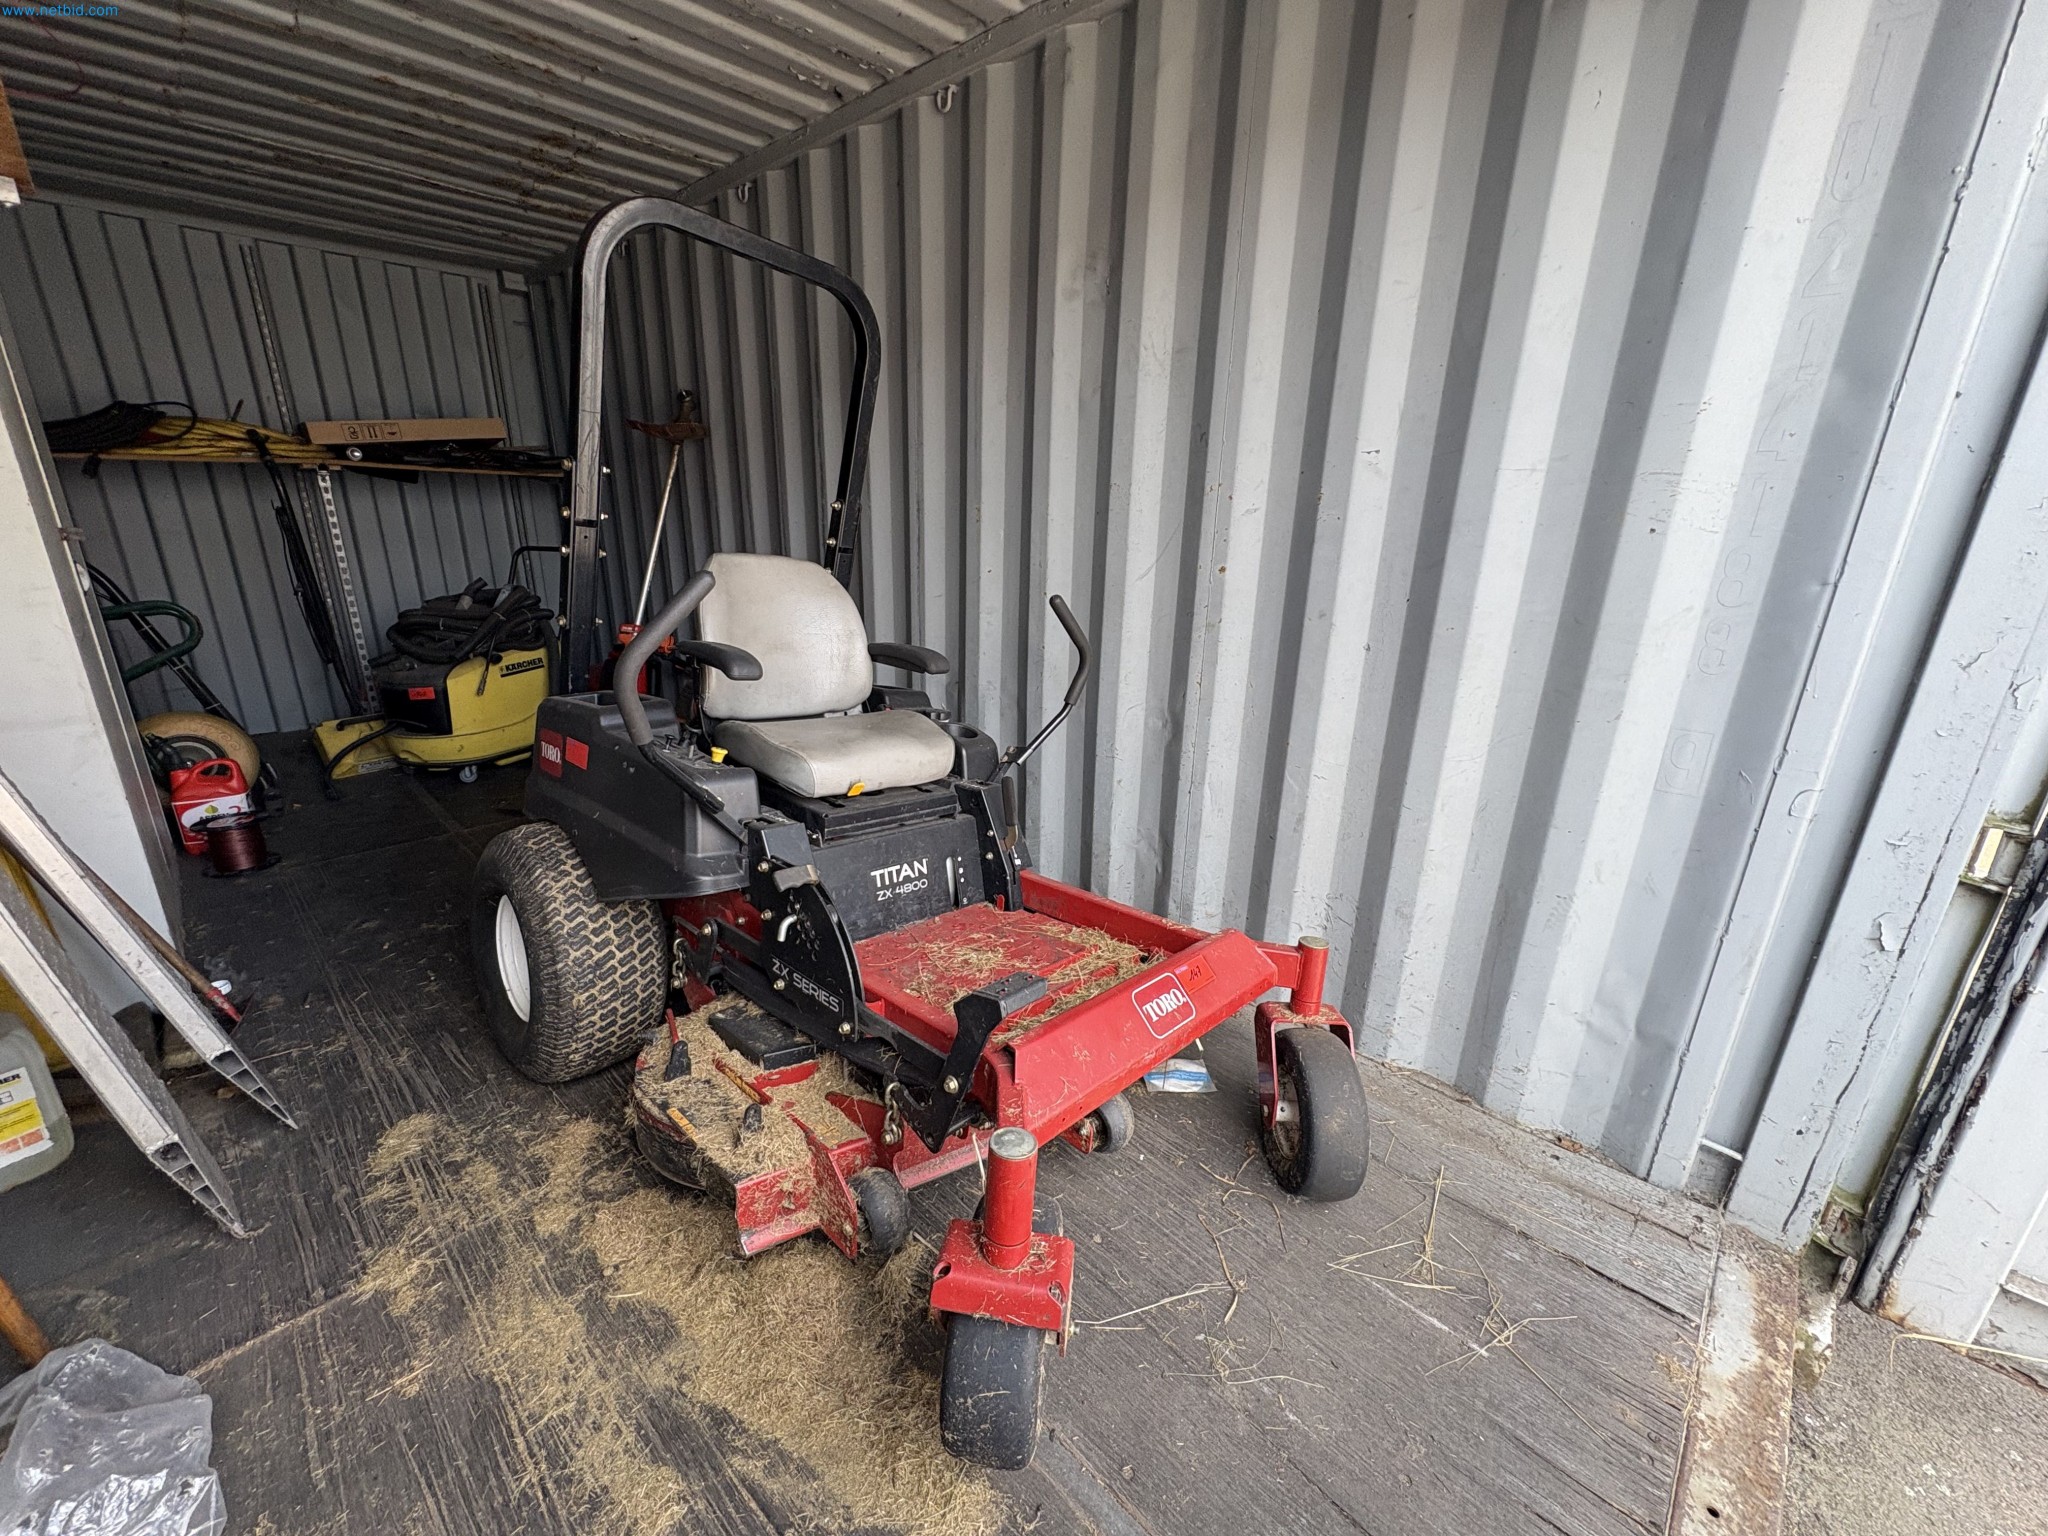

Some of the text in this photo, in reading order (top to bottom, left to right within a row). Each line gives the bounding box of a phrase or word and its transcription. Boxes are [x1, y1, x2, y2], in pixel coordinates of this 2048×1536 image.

[540, 740, 561, 764] TORO
[870, 858, 929, 888] TITAN
[876, 878, 928, 901] ZX 4800
[772, 957, 840, 1013] ZX SERIES
[1142, 988, 1187, 1022] TORO
